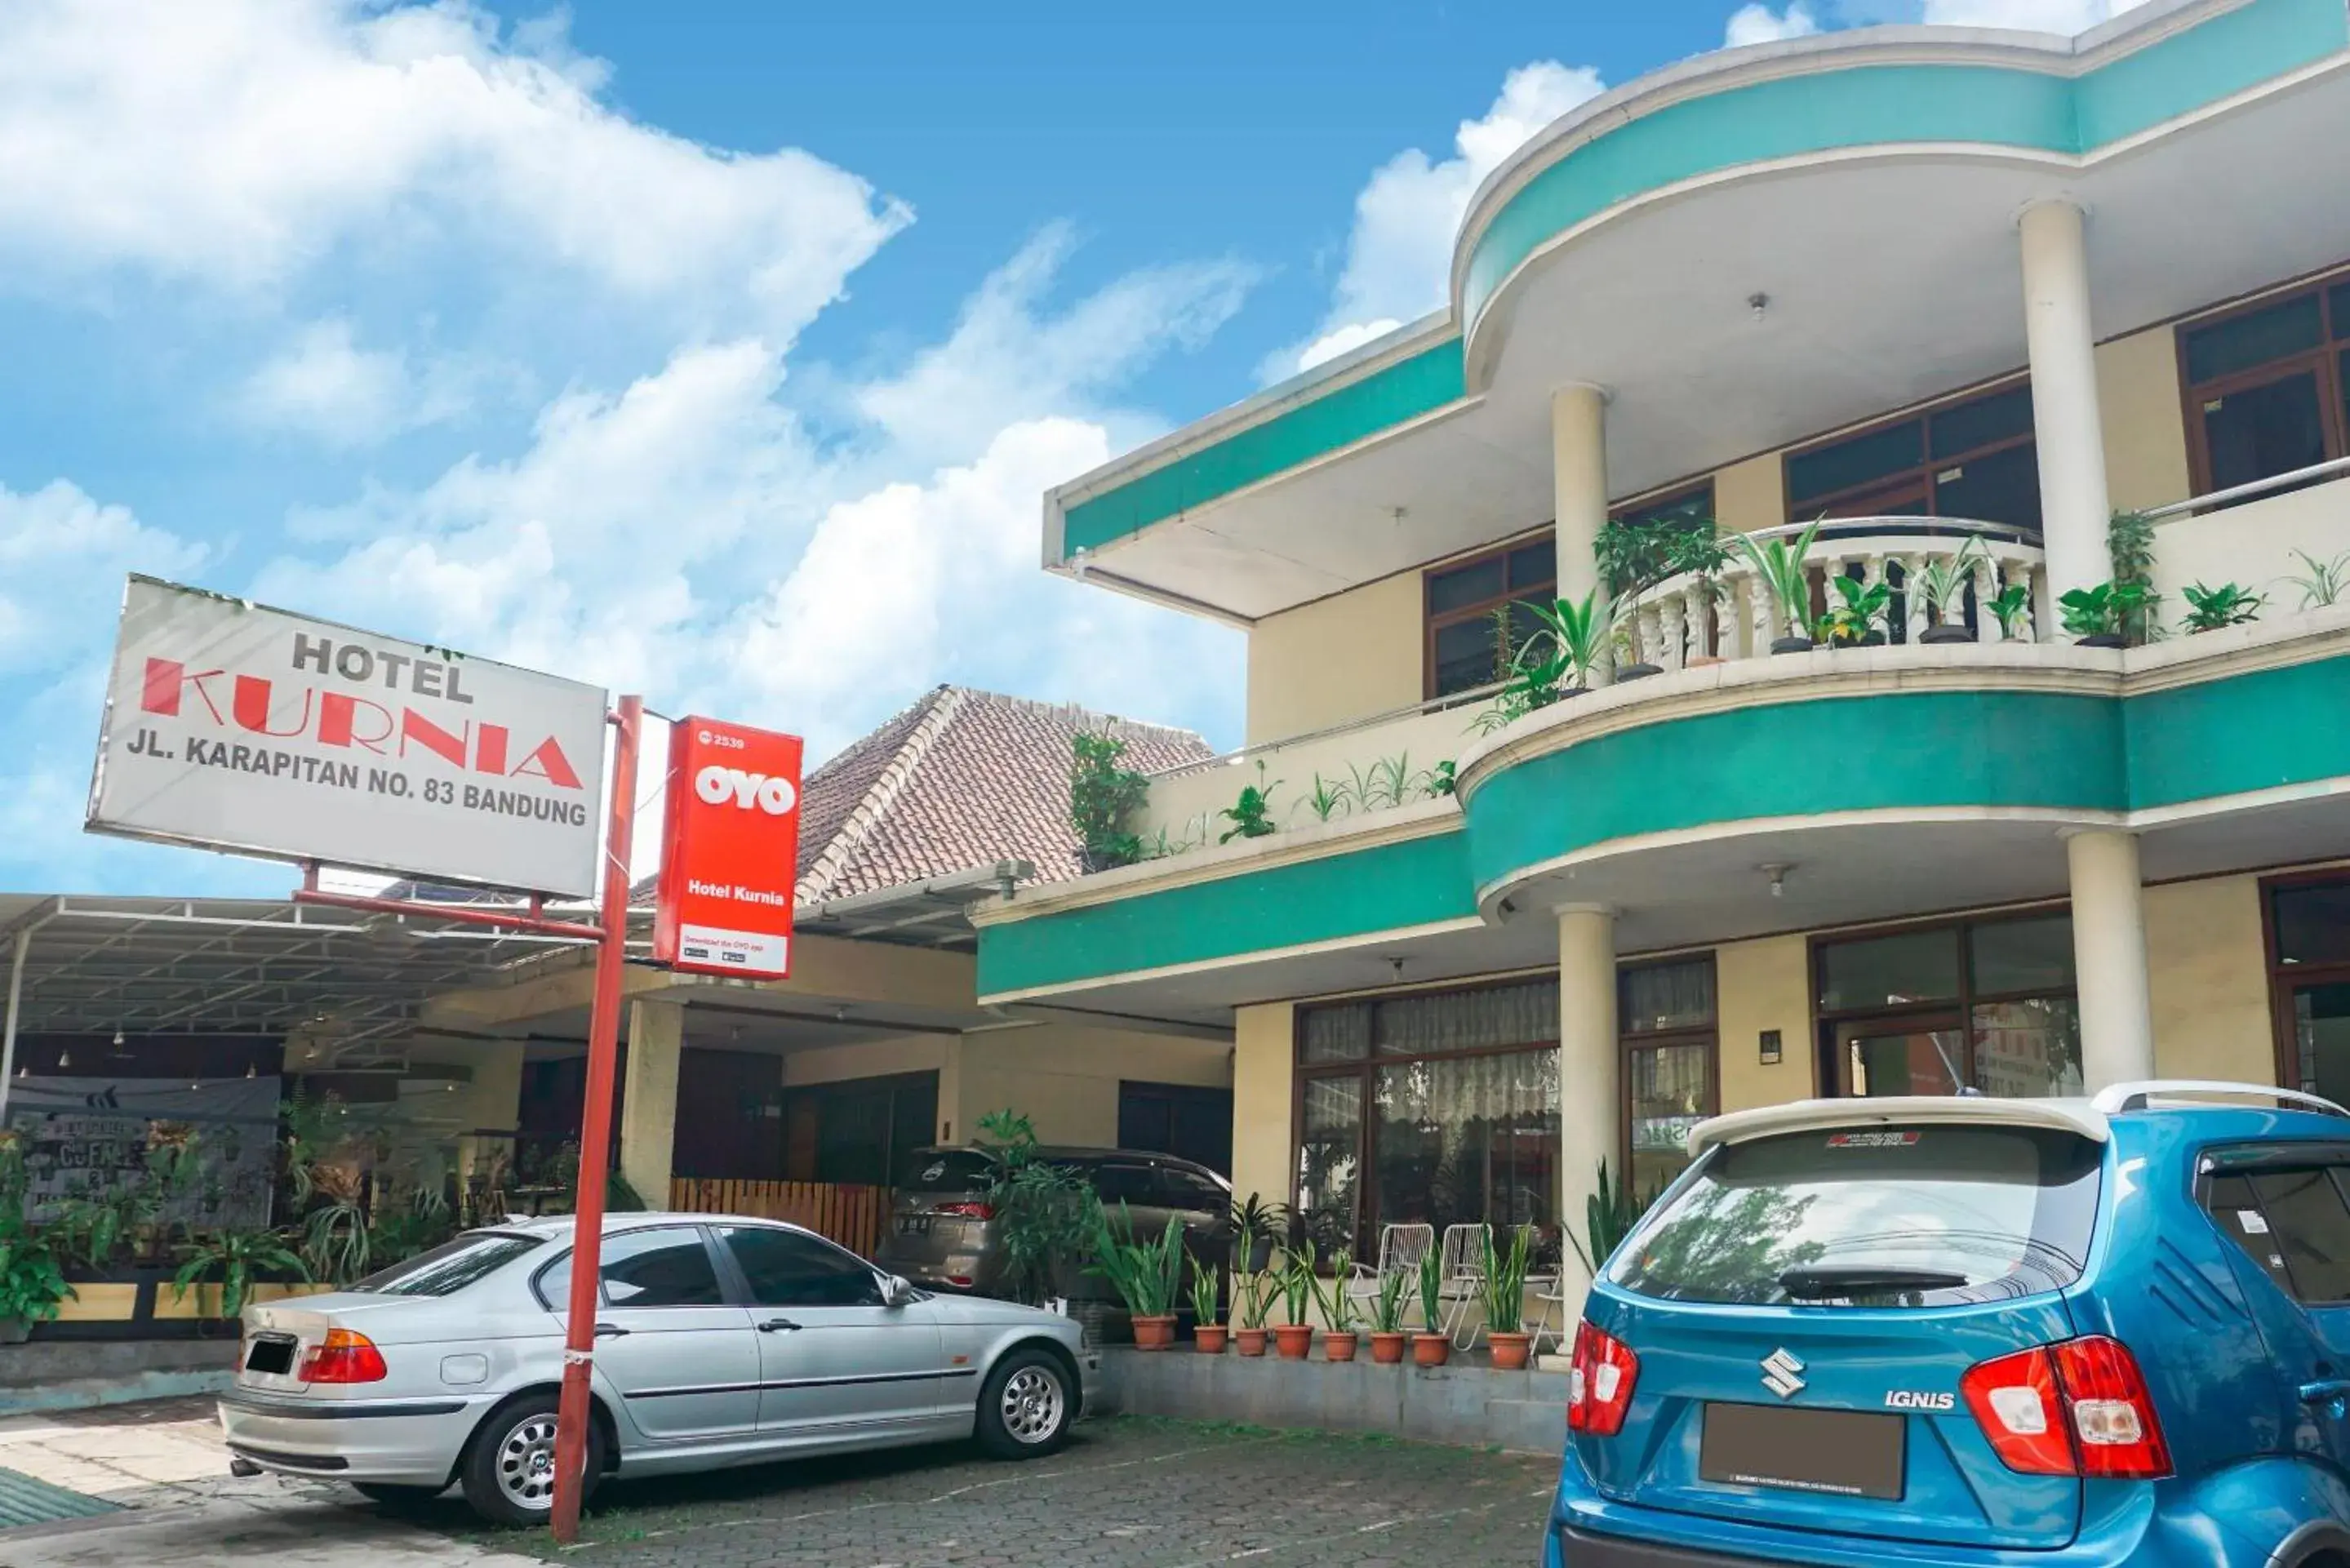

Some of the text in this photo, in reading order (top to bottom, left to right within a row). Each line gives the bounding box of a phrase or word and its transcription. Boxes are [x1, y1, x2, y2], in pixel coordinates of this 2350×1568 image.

[291, 632, 473, 704] HOTEL
[140, 657, 584, 789] KURNIA
[127, 728, 586, 827] JL. KARAPITAN NO. 83 BANDUNG
[695, 766, 796, 815] OYO
[689, 880, 784, 906] Hotel Kurnia
[1885, 1390, 1955, 1410] IGNIS
